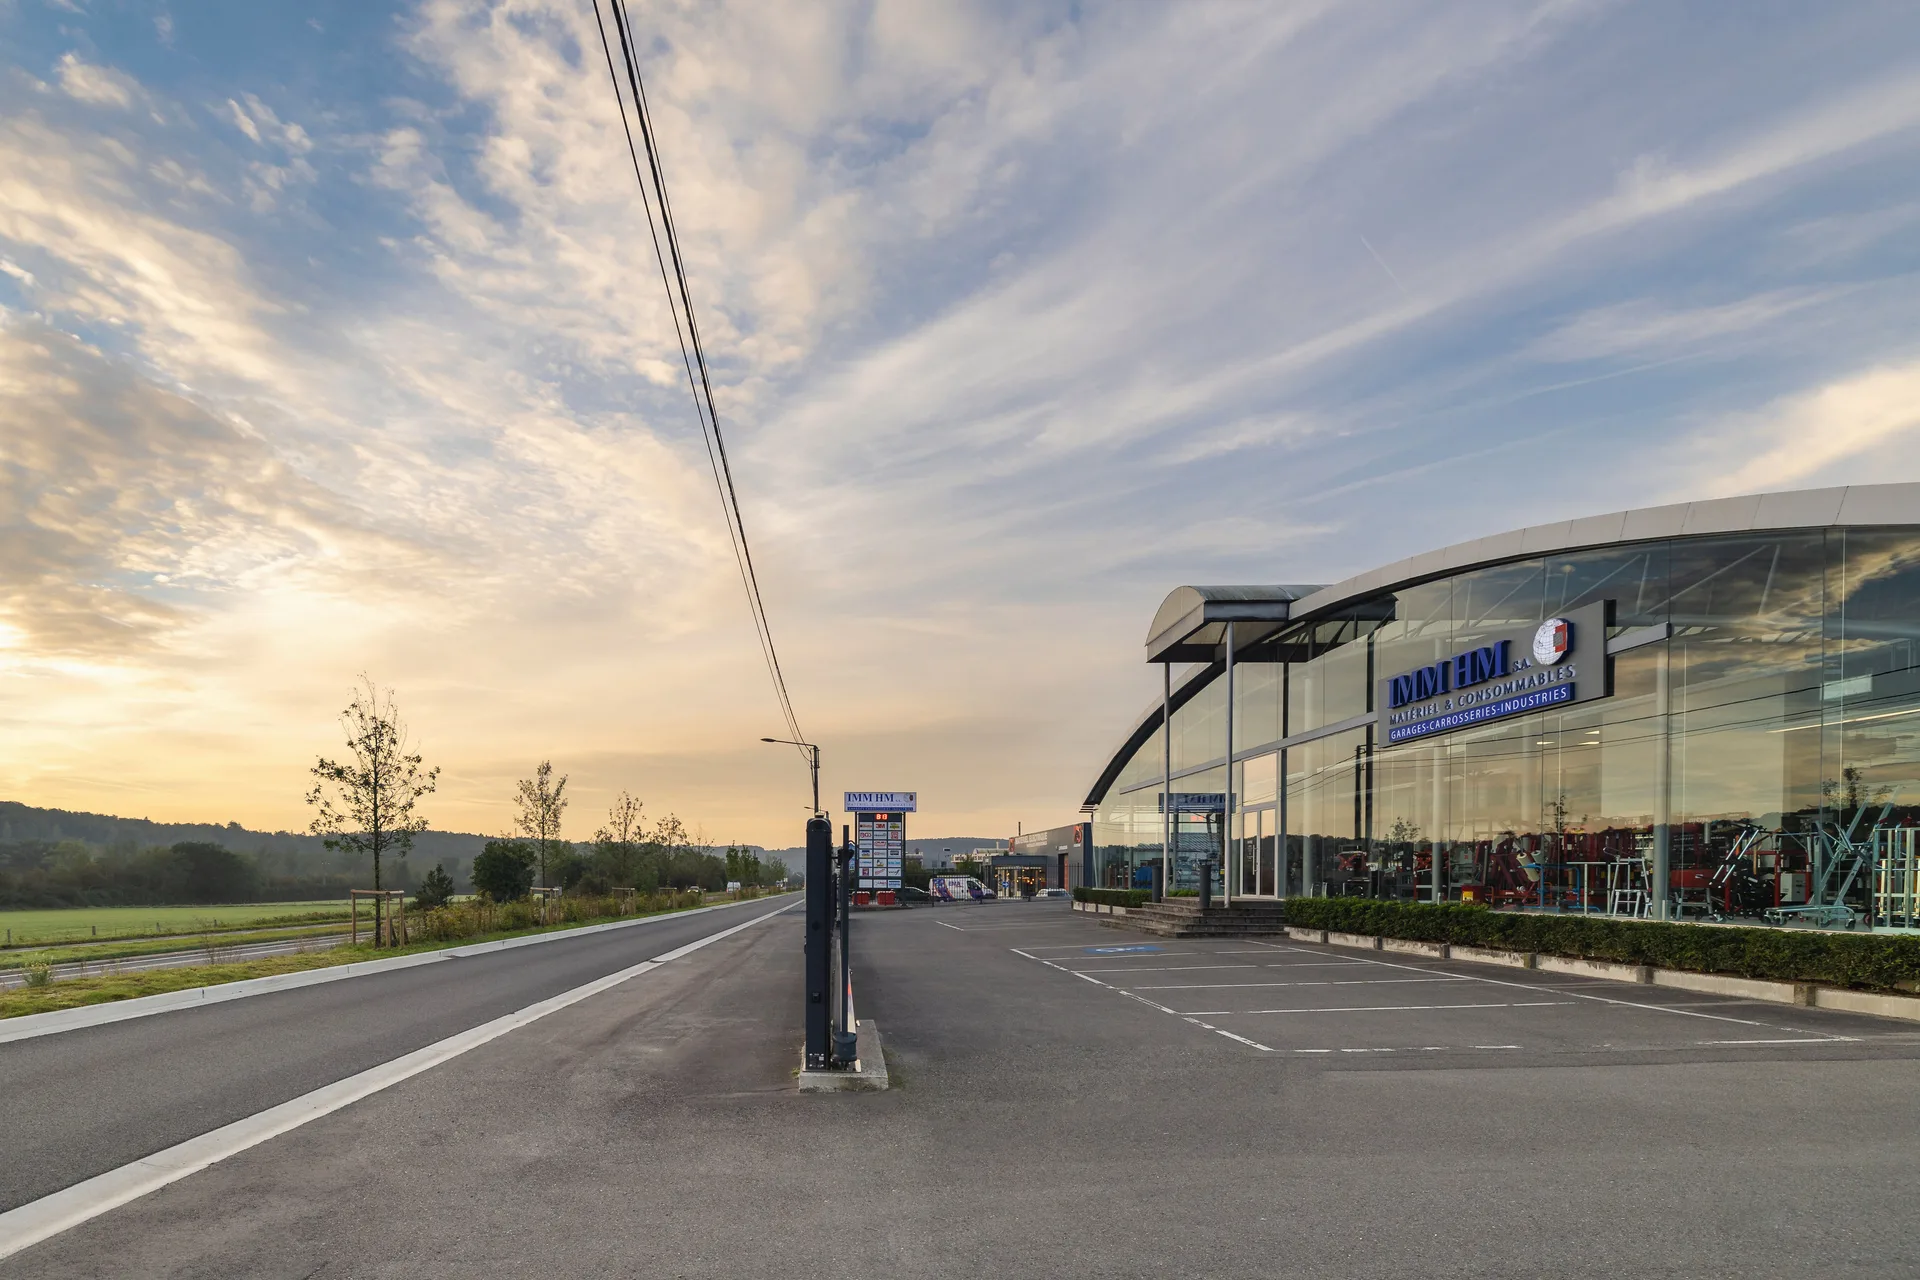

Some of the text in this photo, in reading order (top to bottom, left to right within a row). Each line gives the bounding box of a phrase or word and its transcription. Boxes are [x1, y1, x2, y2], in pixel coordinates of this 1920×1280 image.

[1388, 661, 1451, 709] IMM
[1451, 640, 1511, 690] HM
[1389, 664, 1576, 725] MATÉRIEL & CONSOMMABLES
[1391, 687, 1568, 740] GARAGES-CARROSSERIES-INDUSTRIES
[848, 793, 894, 802] IMM HM
